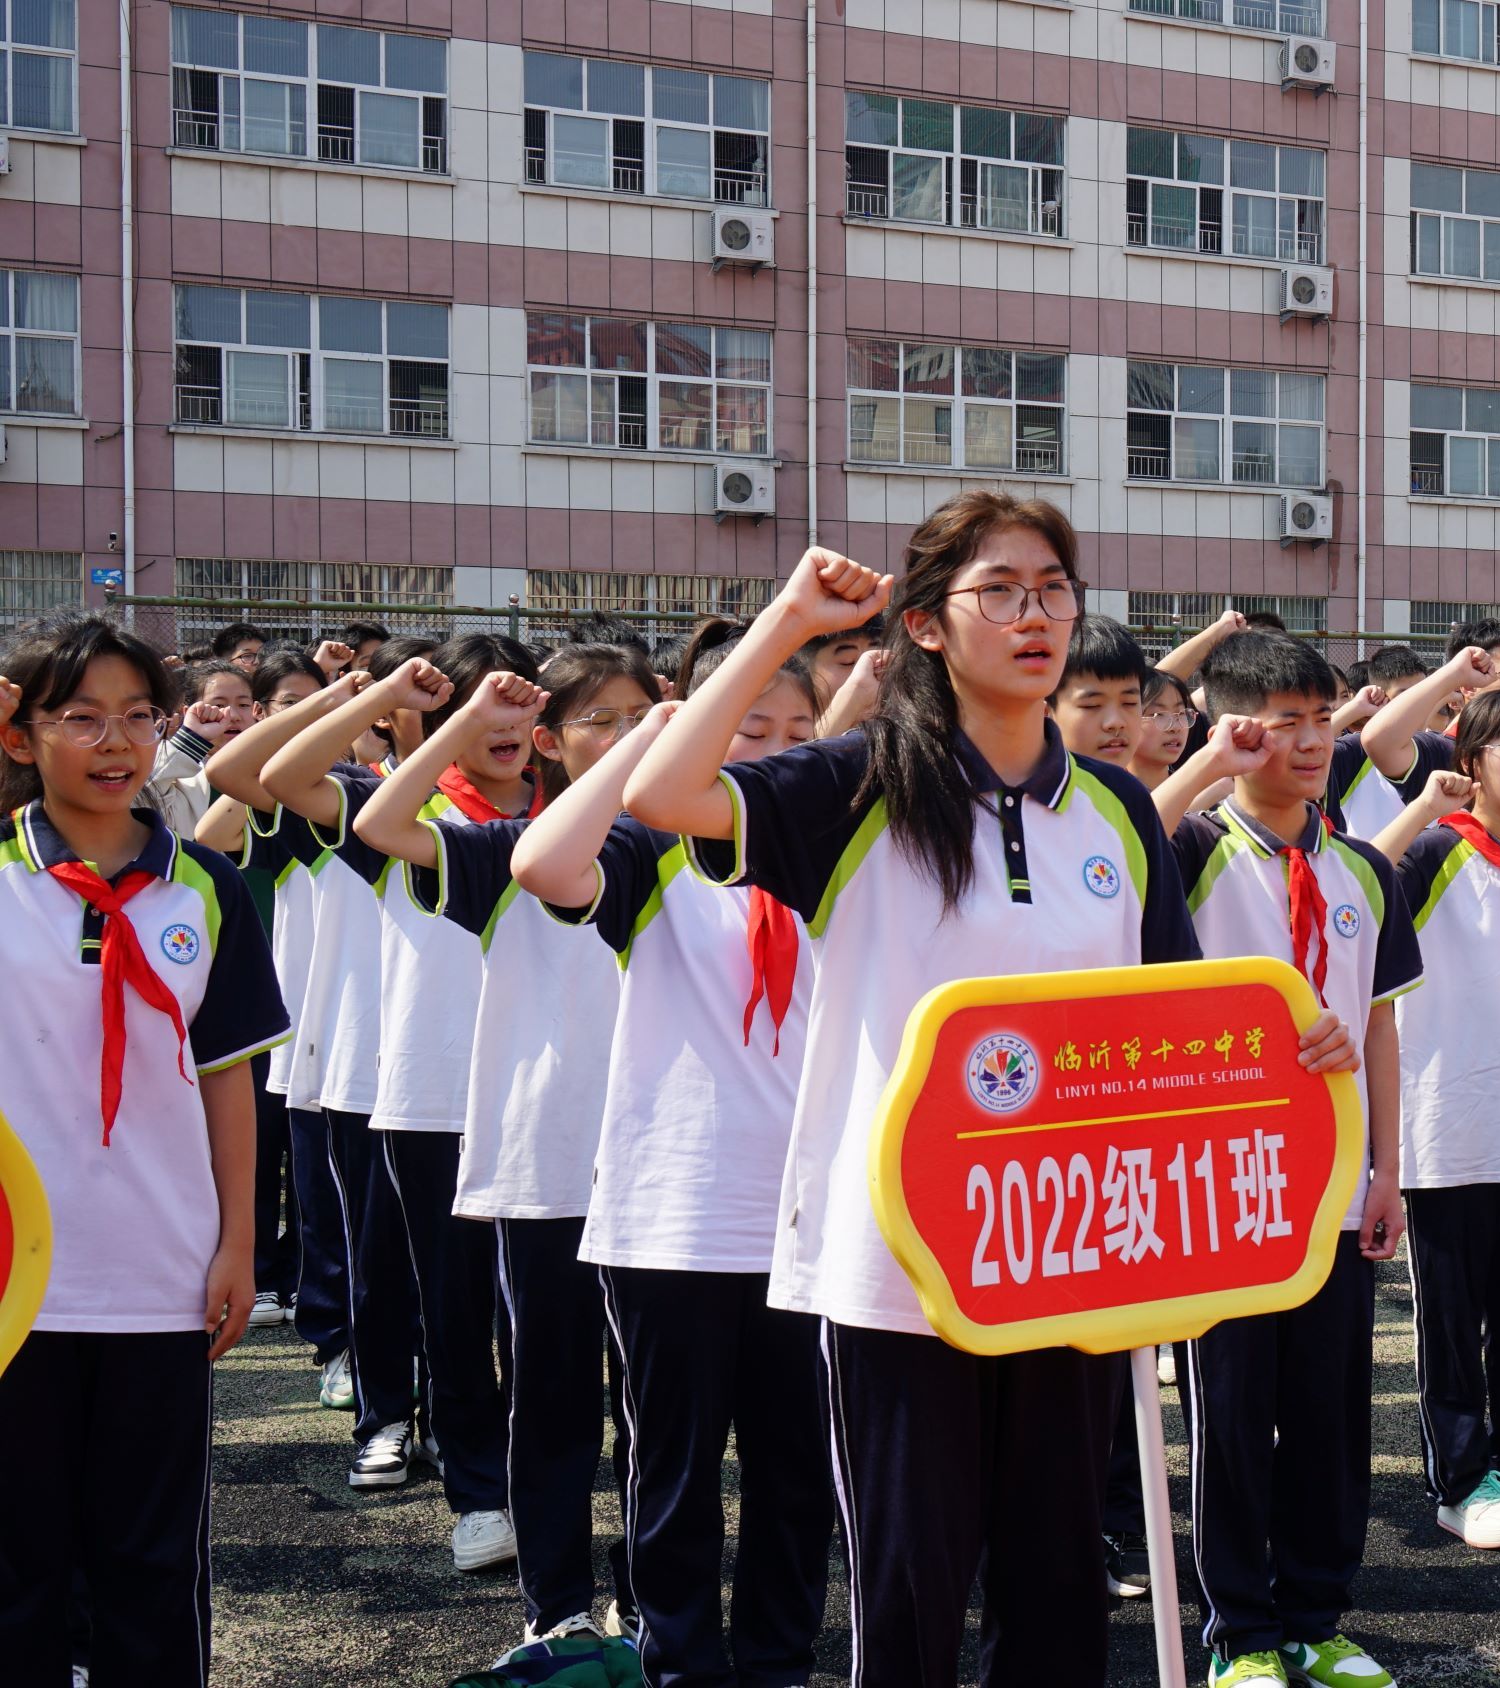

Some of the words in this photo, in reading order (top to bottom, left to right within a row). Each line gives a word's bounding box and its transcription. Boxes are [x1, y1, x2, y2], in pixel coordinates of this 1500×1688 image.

[1054, 1027, 1265, 1072] 临沂第十四中学
[1056, 1083, 1095, 1100] LINYI
[1102, 1079, 1147, 1095] NO.14
[1153, 1073, 1206, 1090] MIDDLE
[1213, 1067, 1266, 1084] SCHOOL
[966, 1128, 1293, 1288] 2022级11班
